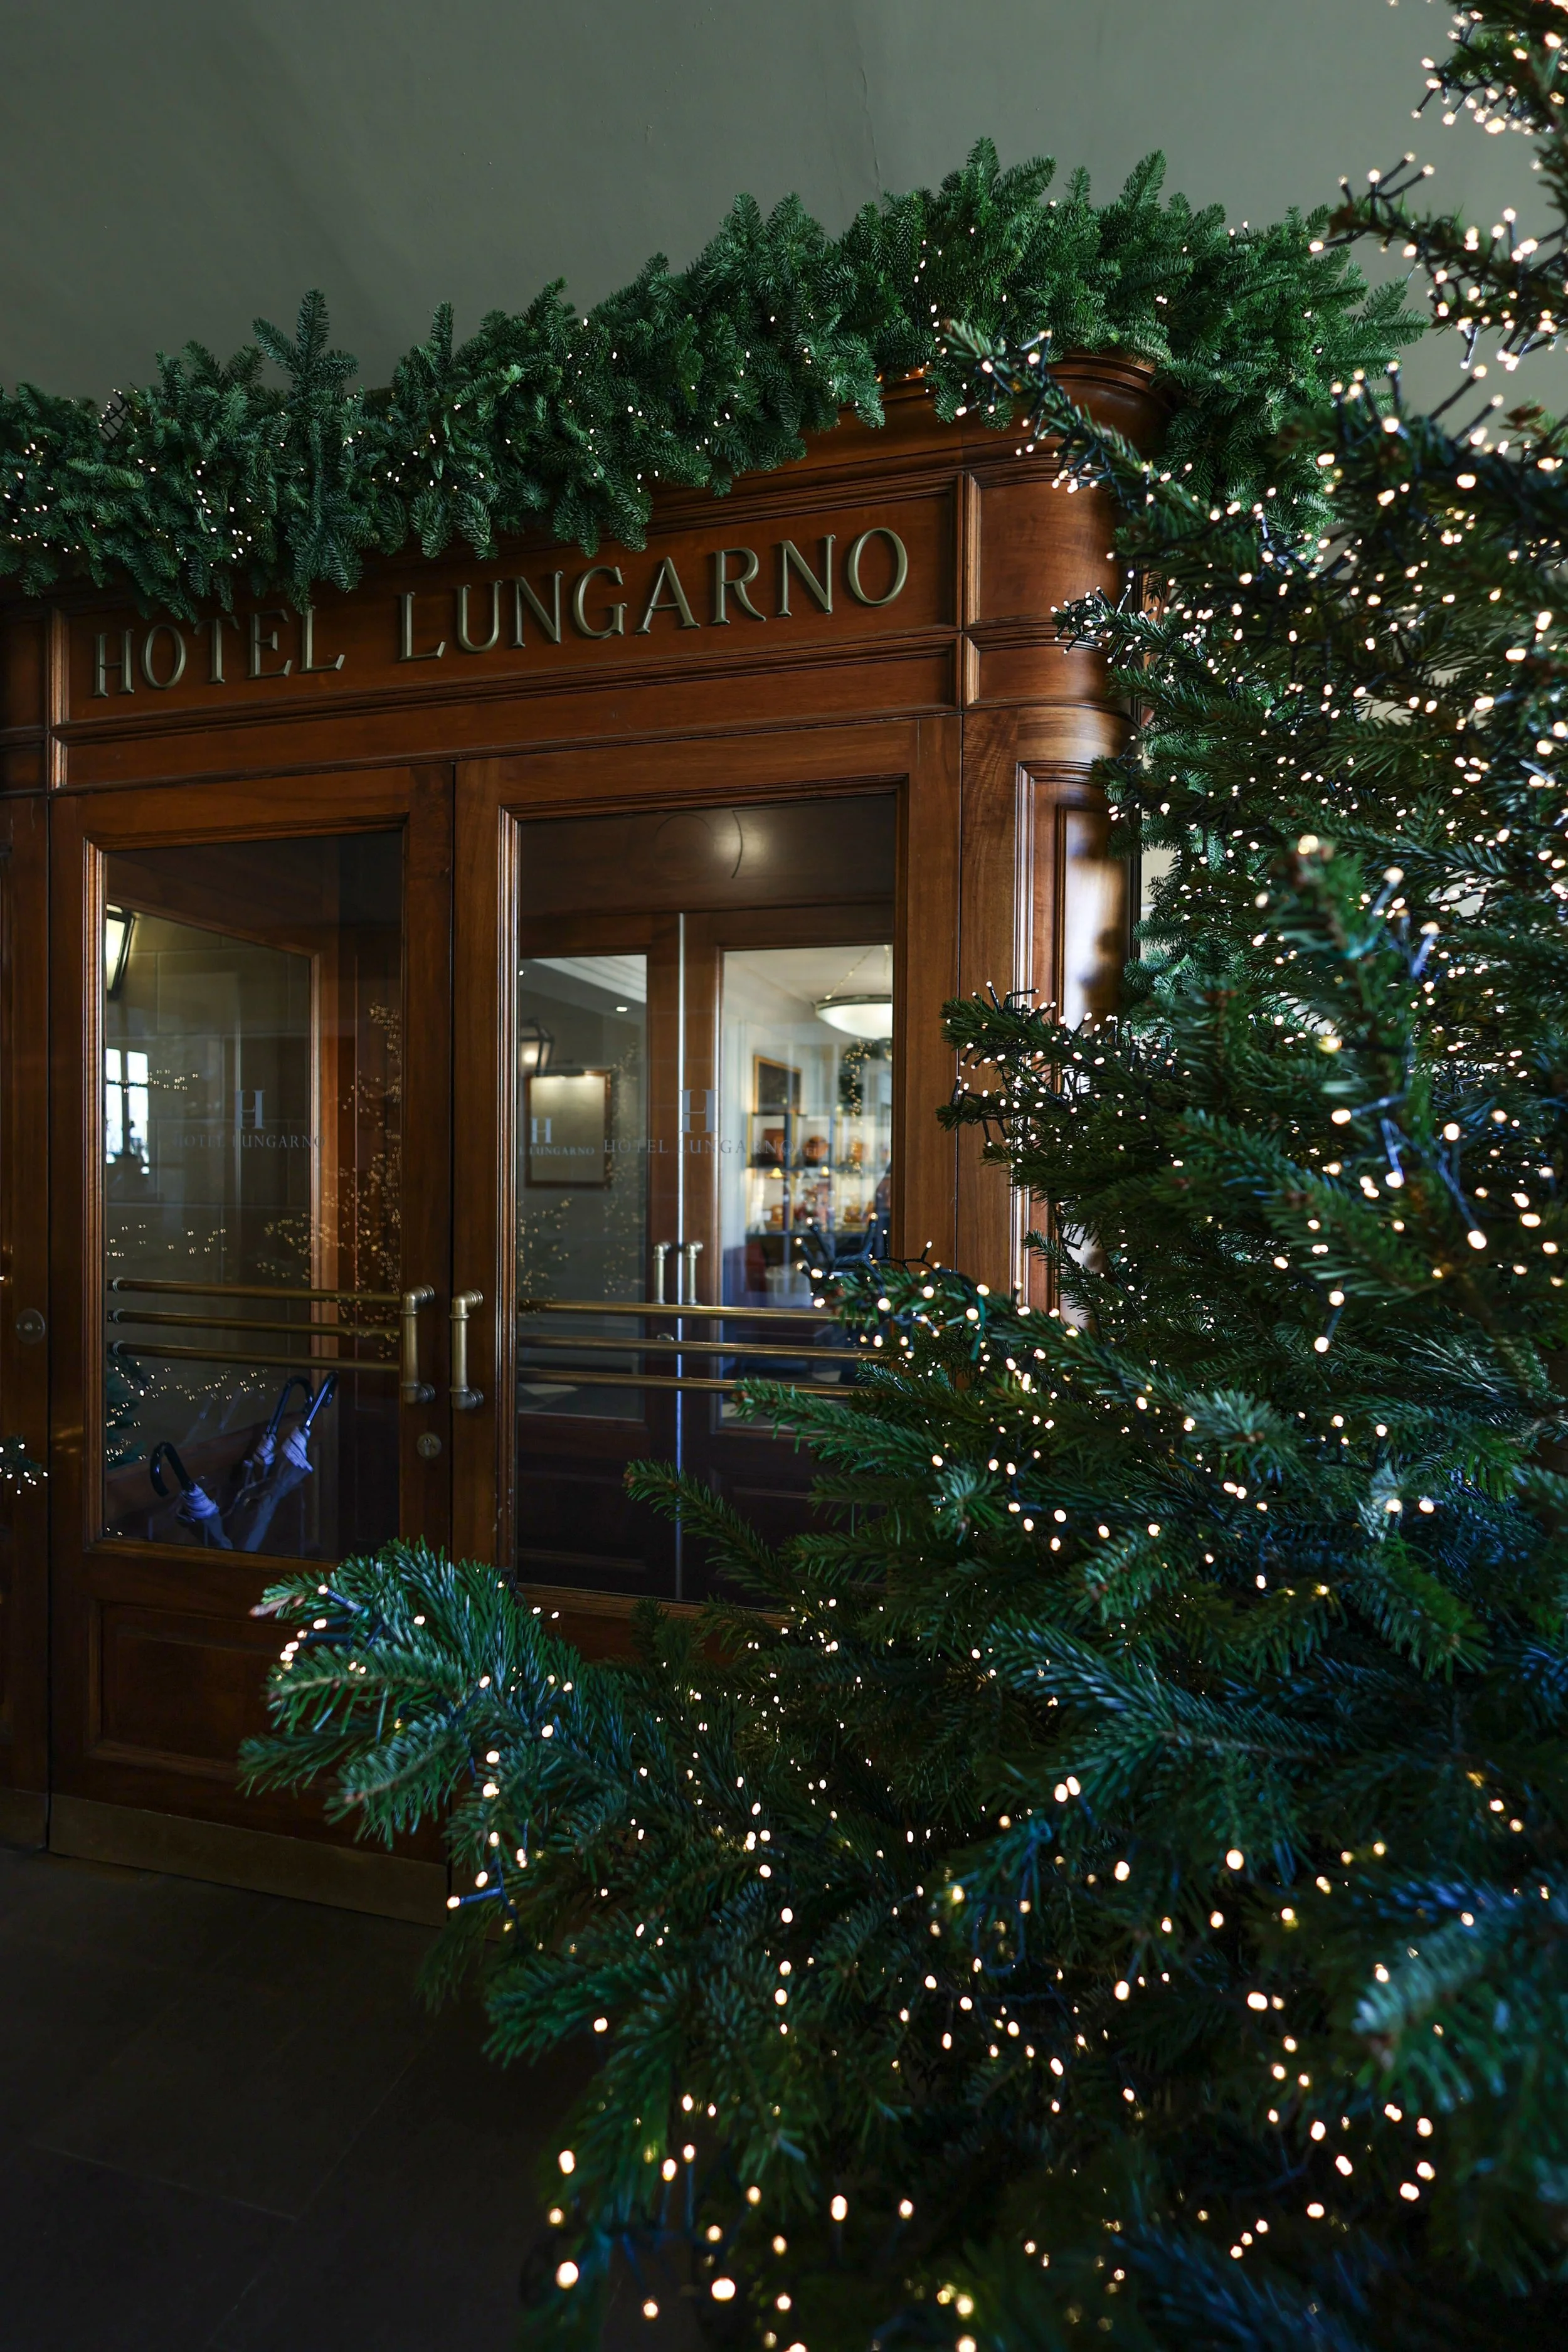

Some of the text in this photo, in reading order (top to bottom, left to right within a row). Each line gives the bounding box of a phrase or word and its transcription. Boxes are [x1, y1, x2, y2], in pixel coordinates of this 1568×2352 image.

[92, 527, 909, 697] HOTEL LUNGARNO
[234, 1089, 266, 1130] H
[676, 1089, 720, 1133] H
[233, 1135, 326, 1148] LUNGARNO
[530, 1117, 552, 1144] H
[529, 1146, 595, 1155] LUNGARNO
[604, 1139, 669, 1153] HOTEL
[677, 1139, 795, 1155] LUNGARNO
